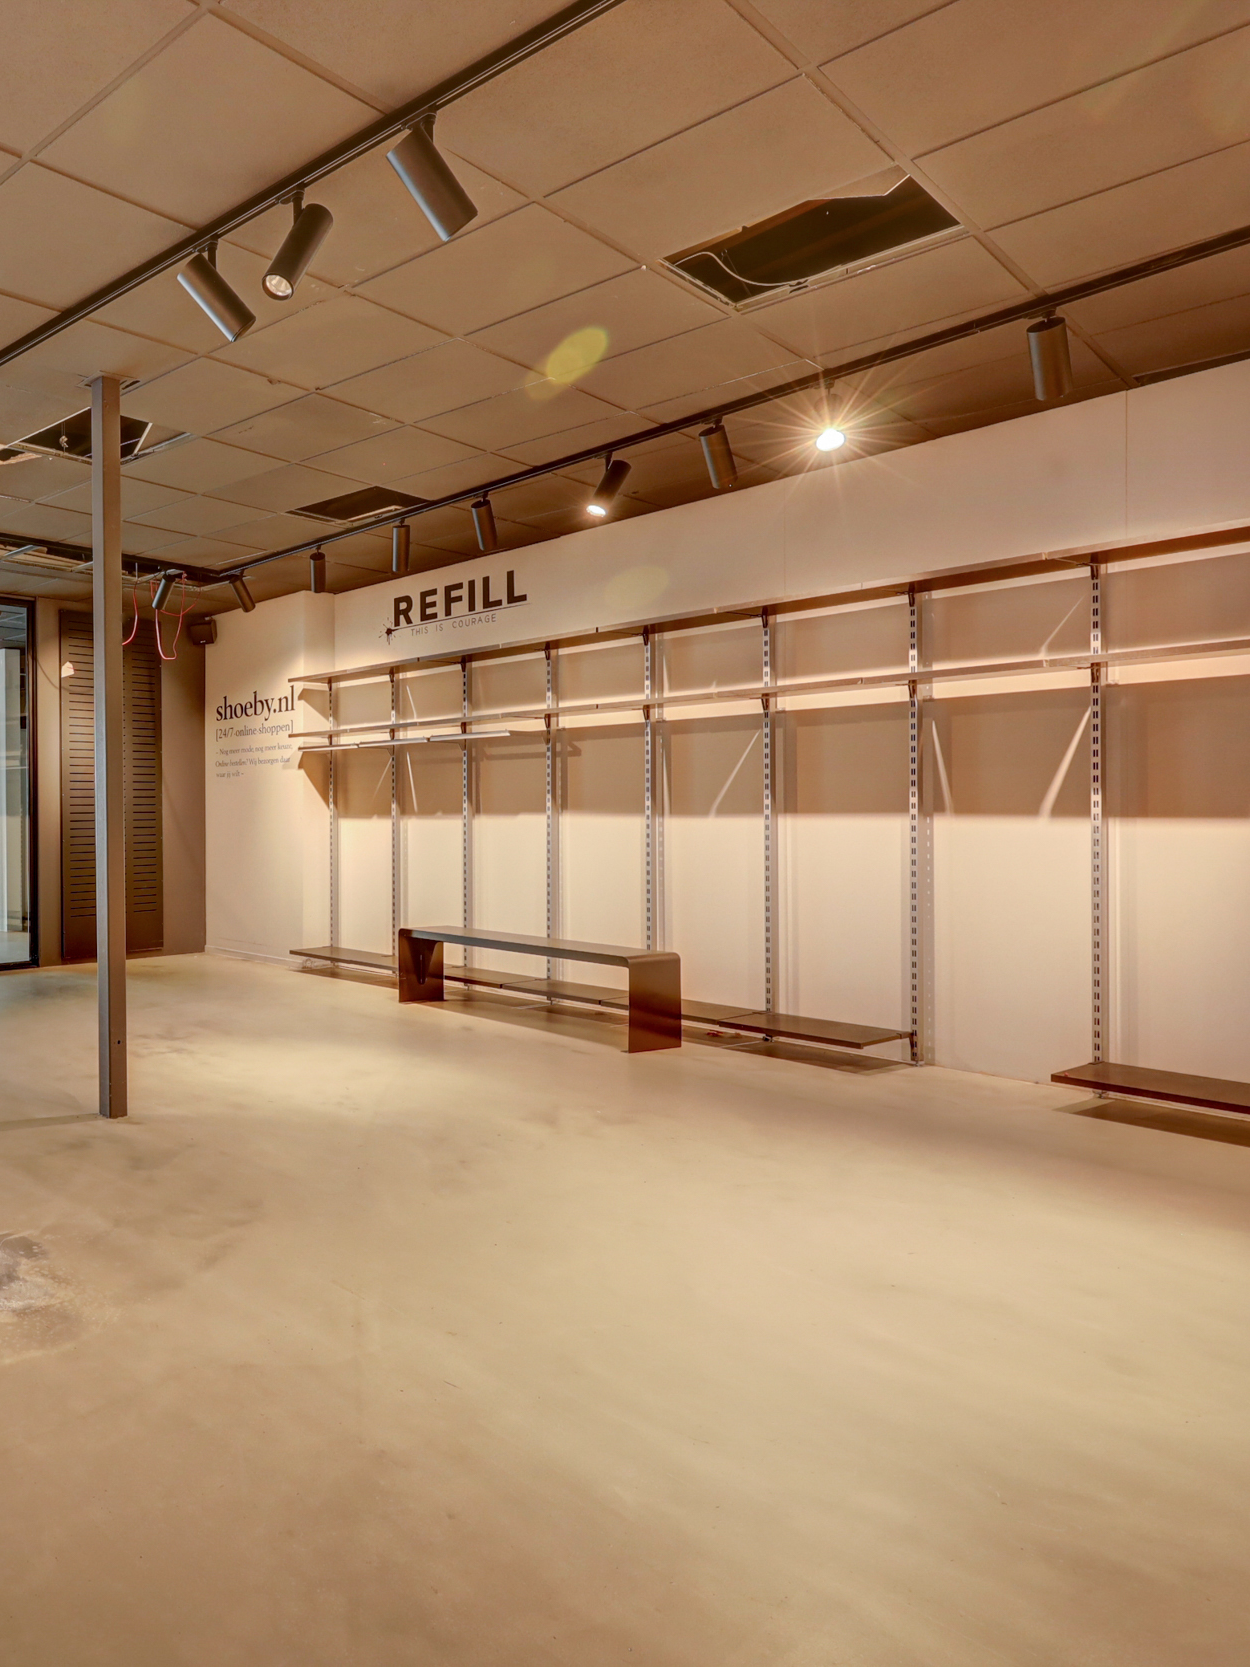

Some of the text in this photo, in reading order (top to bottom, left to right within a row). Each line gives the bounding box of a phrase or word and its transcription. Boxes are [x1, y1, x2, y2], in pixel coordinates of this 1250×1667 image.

[393, 570, 527, 627] REFILL
[410, 613, 497, 637] THIS IS COURAGE
[216, 685, 295, 721] shoeby.nl
